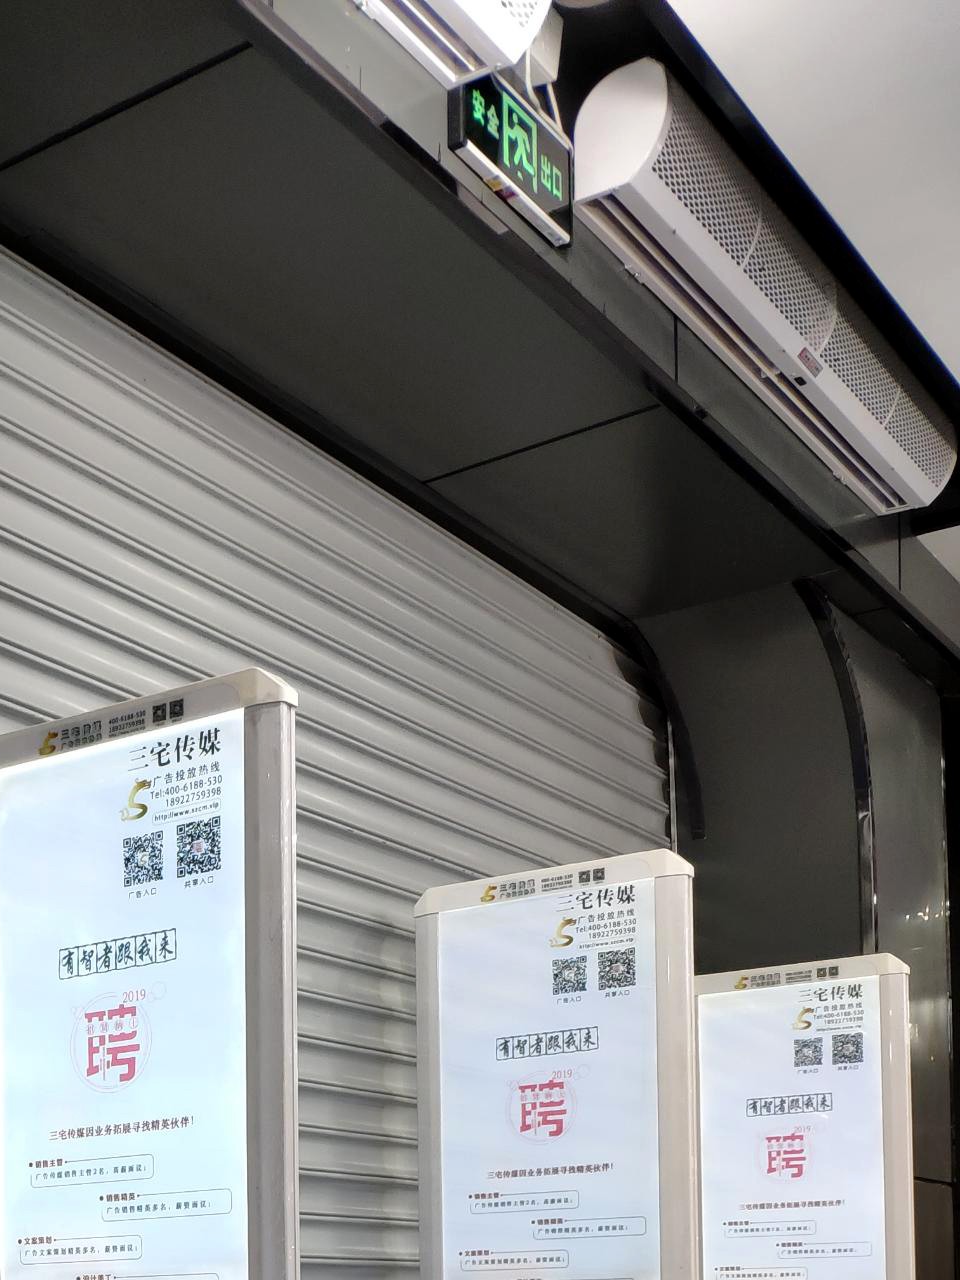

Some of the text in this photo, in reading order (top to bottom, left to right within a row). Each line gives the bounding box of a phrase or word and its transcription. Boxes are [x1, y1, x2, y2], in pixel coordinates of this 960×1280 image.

[541, 153, 563, 201] 出口
[127, 727, 221, 771] 三宅传媒
[153, 761, 220, 788] 广告投放热线
[150, 775, 223, 800] Tel:400-6188-530
[165, 787, 221, 807] 18922759398
[154, 801, 219, 822] http://www.szcm.vip
[183, 875, 215, 889] 共享入口
[555, 884, 636, 913] 三宅传媒
[588, 927, 636, 939] 18922759398
[60, 931, 174, 976] 有智者跟我来
[122, 989, 146, 1003] 2019
[798, 983, 863, 1002] 三宅传媒
[84, 1003, 140, 1082] 聘
[497, 1028, 596, 1058] 有智者跟我来
[551, 1069, 573, 1080] 2019
